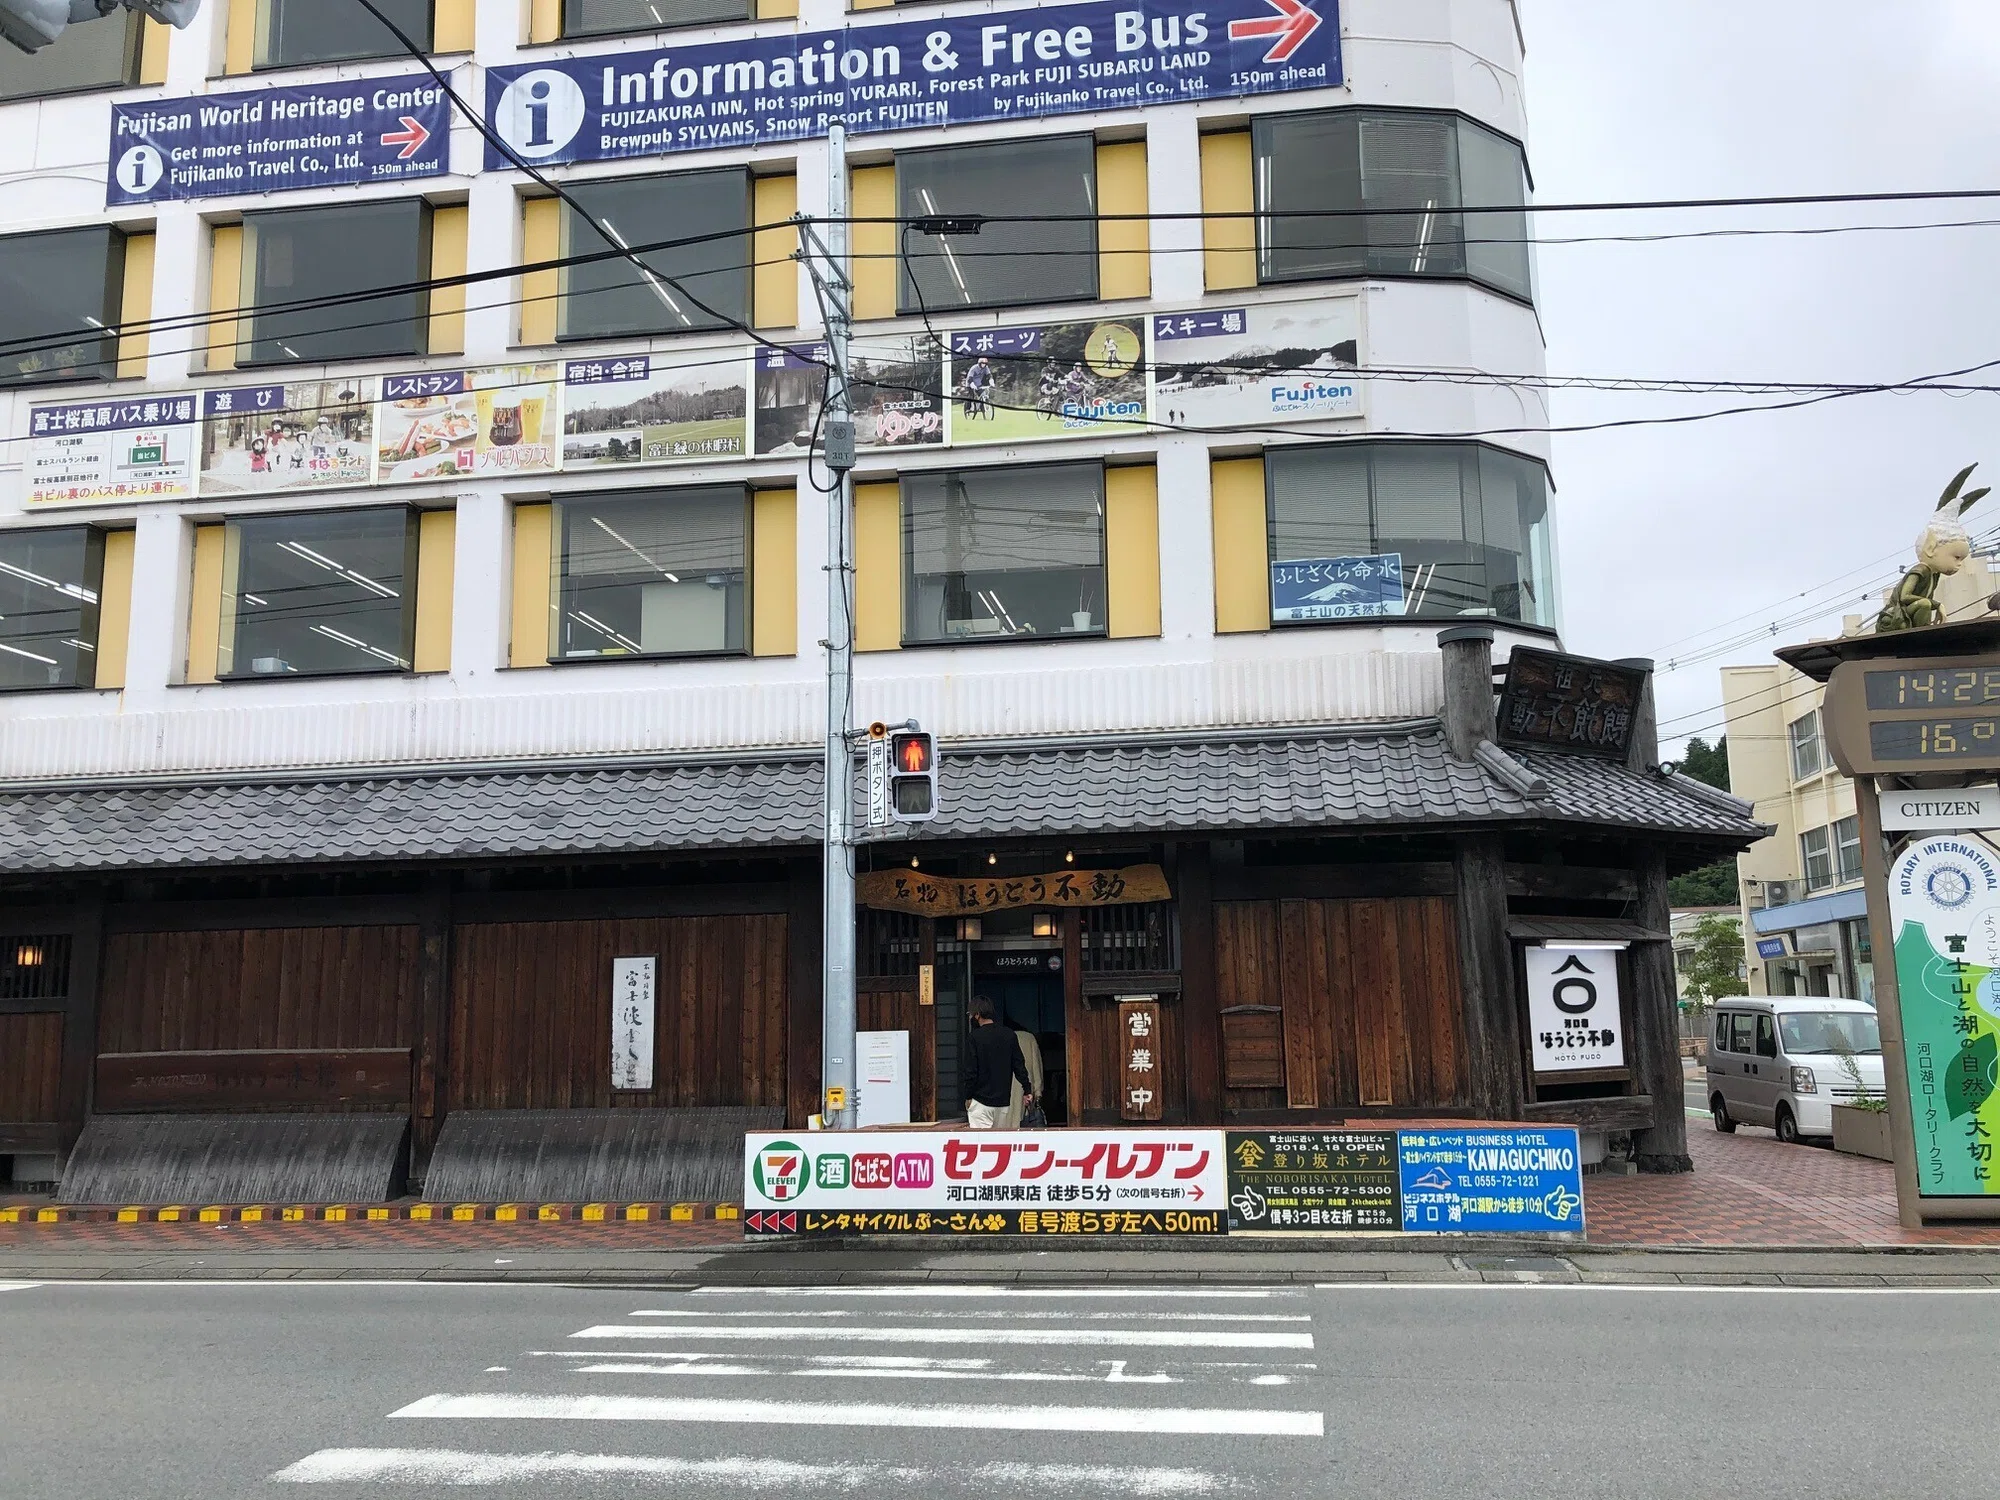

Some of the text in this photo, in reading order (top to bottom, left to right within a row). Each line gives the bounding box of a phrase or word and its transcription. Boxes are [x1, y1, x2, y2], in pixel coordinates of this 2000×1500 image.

[603, 10, 1209, 106] Information & Free Bus
[1231, 64, 1326, 86] 150m ahead
[601, 50, 1211, 128] FUJIZAKURA INN, Hot spring YURARI, Forest Park FUJI SUBARU LAND
[994, 76, 1209, 112] by Fujikanko Travel Co., Ltd.
[117, 86, 445, 138] Fujisan World Heritage Center
[601, 100, 948, 150] Brewpub SYLVANS, Snow Resort FUJITEN
[172, 131, 363, 162] Get more information at
[171, 152, 363, 185] Fujikanko Travel Co., Ltd.
[371, 159, 438, 175] 150m ahead
[1158, 313, 1241, 336] スキー場
[955, 332, 1035, 352] スポーツ
[569, 361, 646, 382] 宿泊・合宿
[387, 377, 459, 396] レストラン
[1272, 384, 1352, 402] Fujiten
[35, 401, 191, 431] 富士桜高原バス乗り場
[1063, 400, 1141, 419] Fujiten
[876, 410, 938, 442] ゆらり
[648, 437, 740, 457] 富士緑の休暇村
[33, 481, 174, 501] 当ビル裏のバス停より運行
[1276, 559, 1399, 584] ふじざくら命水
[1291, 603, 1388, 618] 富士山の天然水
[872, 746, 883, 819] 押ボタン式
[1901, 801, 1980, 817] CITIZEN
[1901, 842, 1997, 895] ROTARY INTERNATIONAL
[895, 873, 1125, 908] 名物 ほうとう不動
[1540, 1029, 1615, 1049] ほうとう不動
[1129, 1012, 1154, 1112] 営業中
[1944, 934, 1991, 1181] 富士山と湖の自然を大切に
[1917, 1042, 1944, 1184] 河口湖ロータリークラブ
[1269, 1135, 1391, 1143] 富士山に近い 壮大な富士山ビュー
[1466, 1135, 1513, 1146] BUSINESS
[1516, 1134, 1548, 1146] HOTEL
[1273, 1153, 1391, 1169] 登り坂ホテル
[1467, 1148, 1573, 1171] KAWAGUCHIKO
[819, 1158, 930, 1185] 酒 たばこ ATM
[1266, 1174, 1348, 1184] NOBORISAKA
[1458, 1175, 1539, 1187] TEL 0555-72-1221
[947, 1185, 1041, 1201] 河口湖駅東店
[1047, 1185, 1112, 1201] 徒歩5分
[1266, 1186, 1391, 1195] TEL 0555-72-5300
[1403, 1193, 1460, 1203] ビジネスホテル
[1405, 1204, 1462, 1223] 河口湖
[1461, 1196, 1543, 1214] 河口湖駅から徒歩10分
[1019, 1211, 1218, 1233] 信号渡らず左へ50m!
[1270, 1209, 1353, 1225] 信号3つ目を左折
